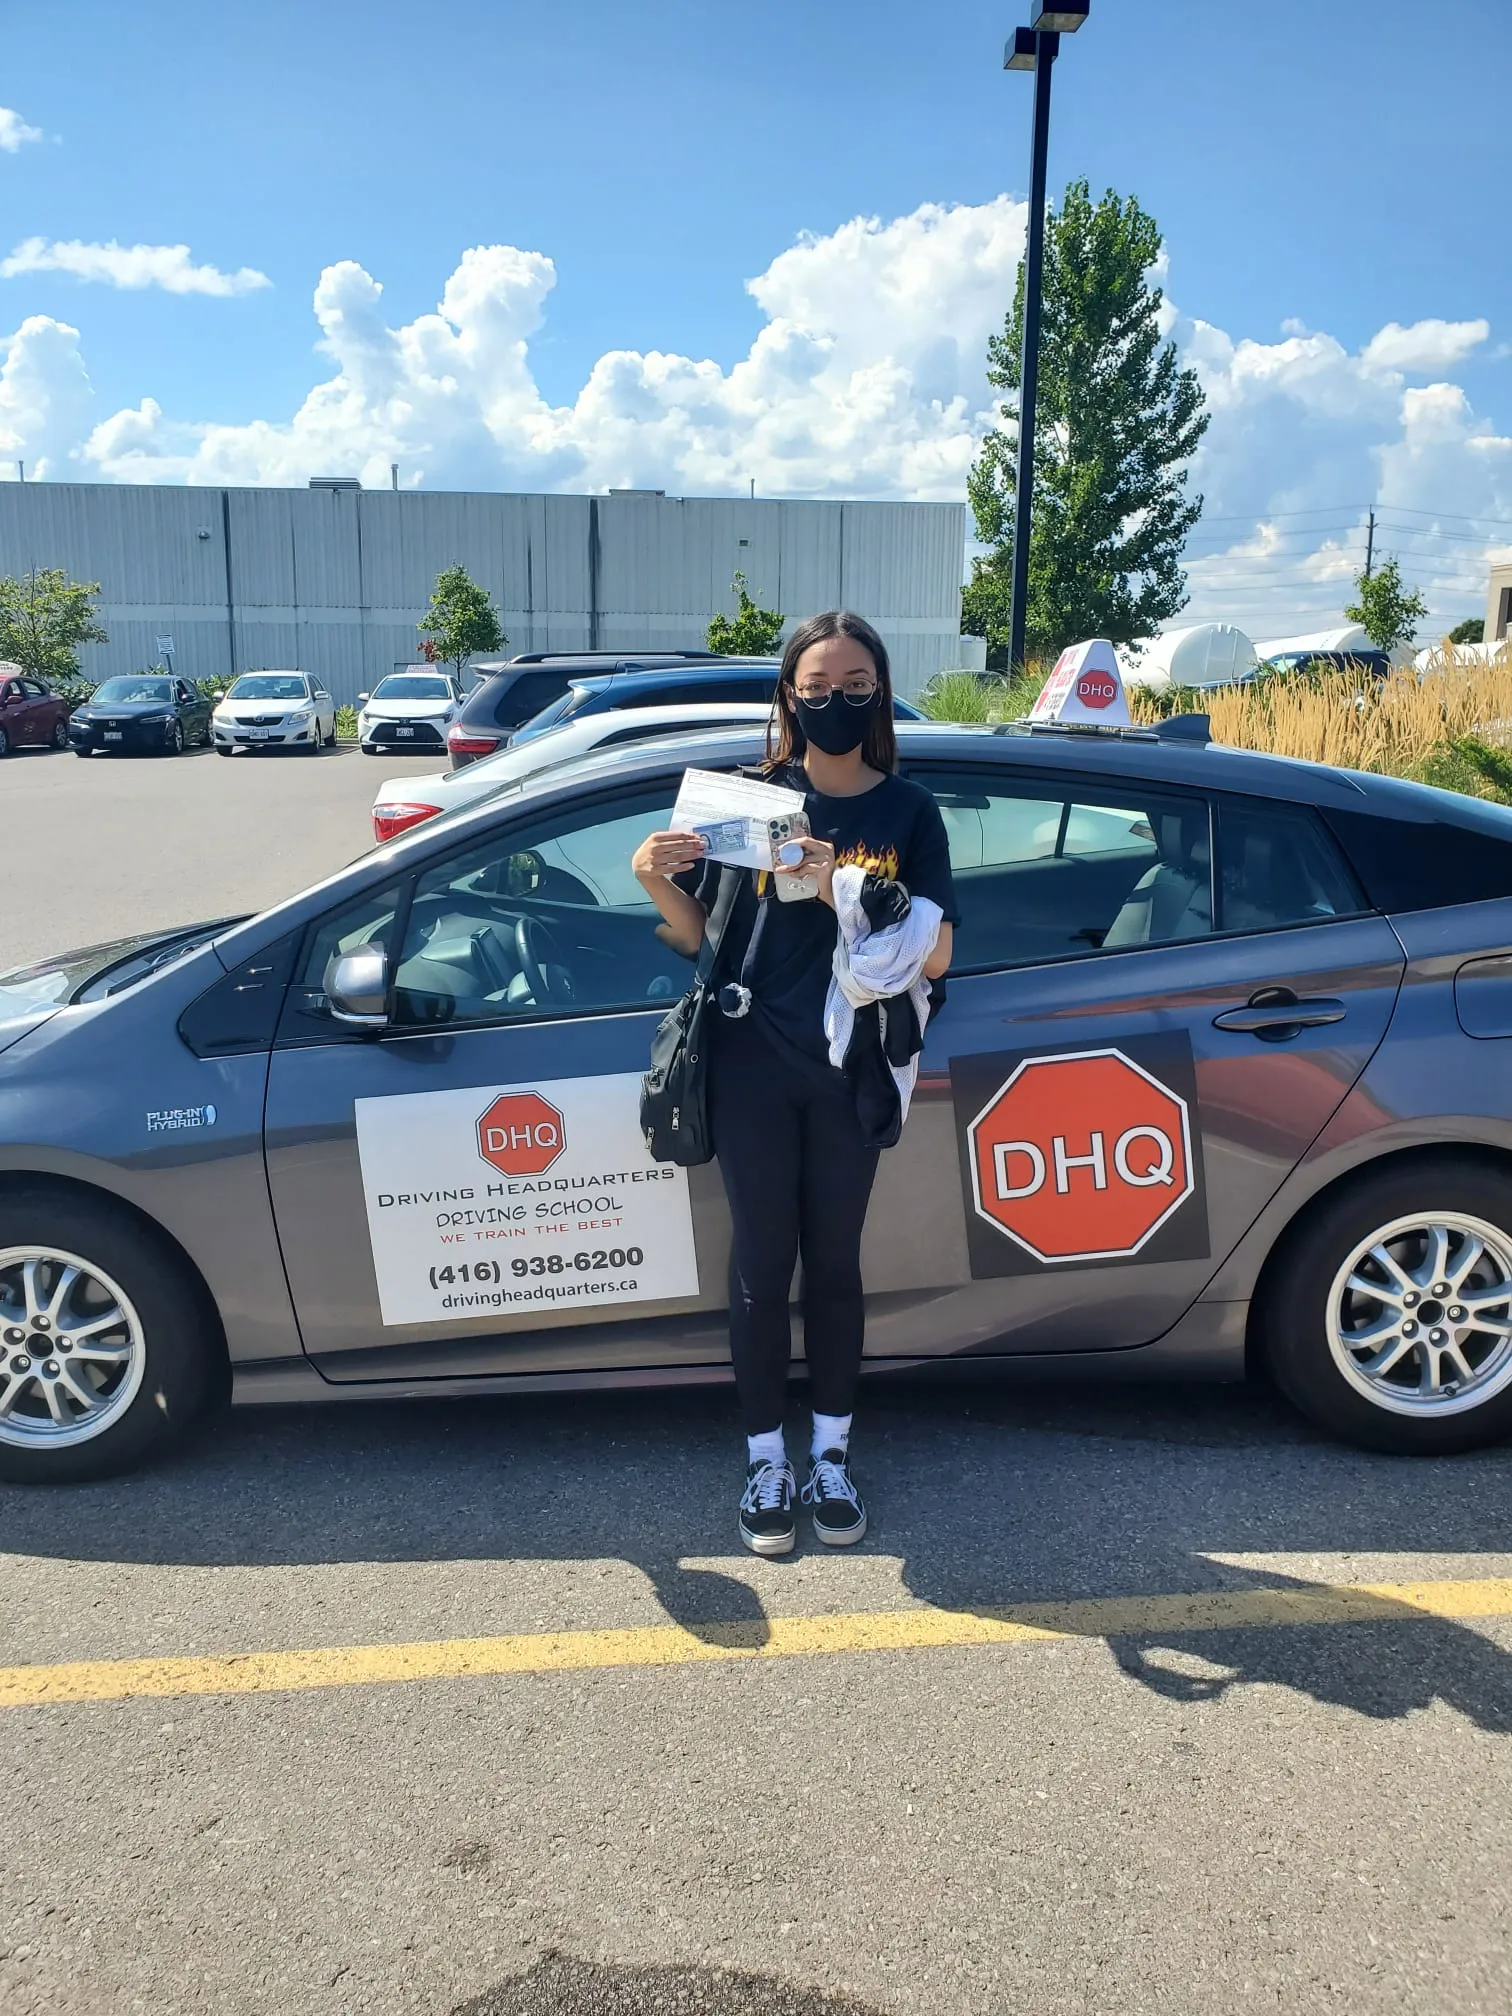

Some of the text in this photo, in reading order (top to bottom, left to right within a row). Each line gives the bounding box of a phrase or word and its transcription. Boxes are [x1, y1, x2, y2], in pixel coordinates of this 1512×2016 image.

[1079, 682, 1115, 698] DHQ
[147, 1107, 203, 1121] PLUG-IN
[147, 1118, 204, 1131] HYBRID
[486, 1122, 559, 1153] DHQ
[992, 1124, 1176, 1202] DHQ
[378, 1168, 675, 1207] DRIVING HEADQUARTERS
[436, 1196, 623, 1228] DRIVING SCHOOL
[440, 1217, 623, 1244] WE TRAIN THE BEST
[429, 1246, 644, 1290] (416) 938-6200
[442, 1278, 638, 1308] drivingheadquarters.ca
